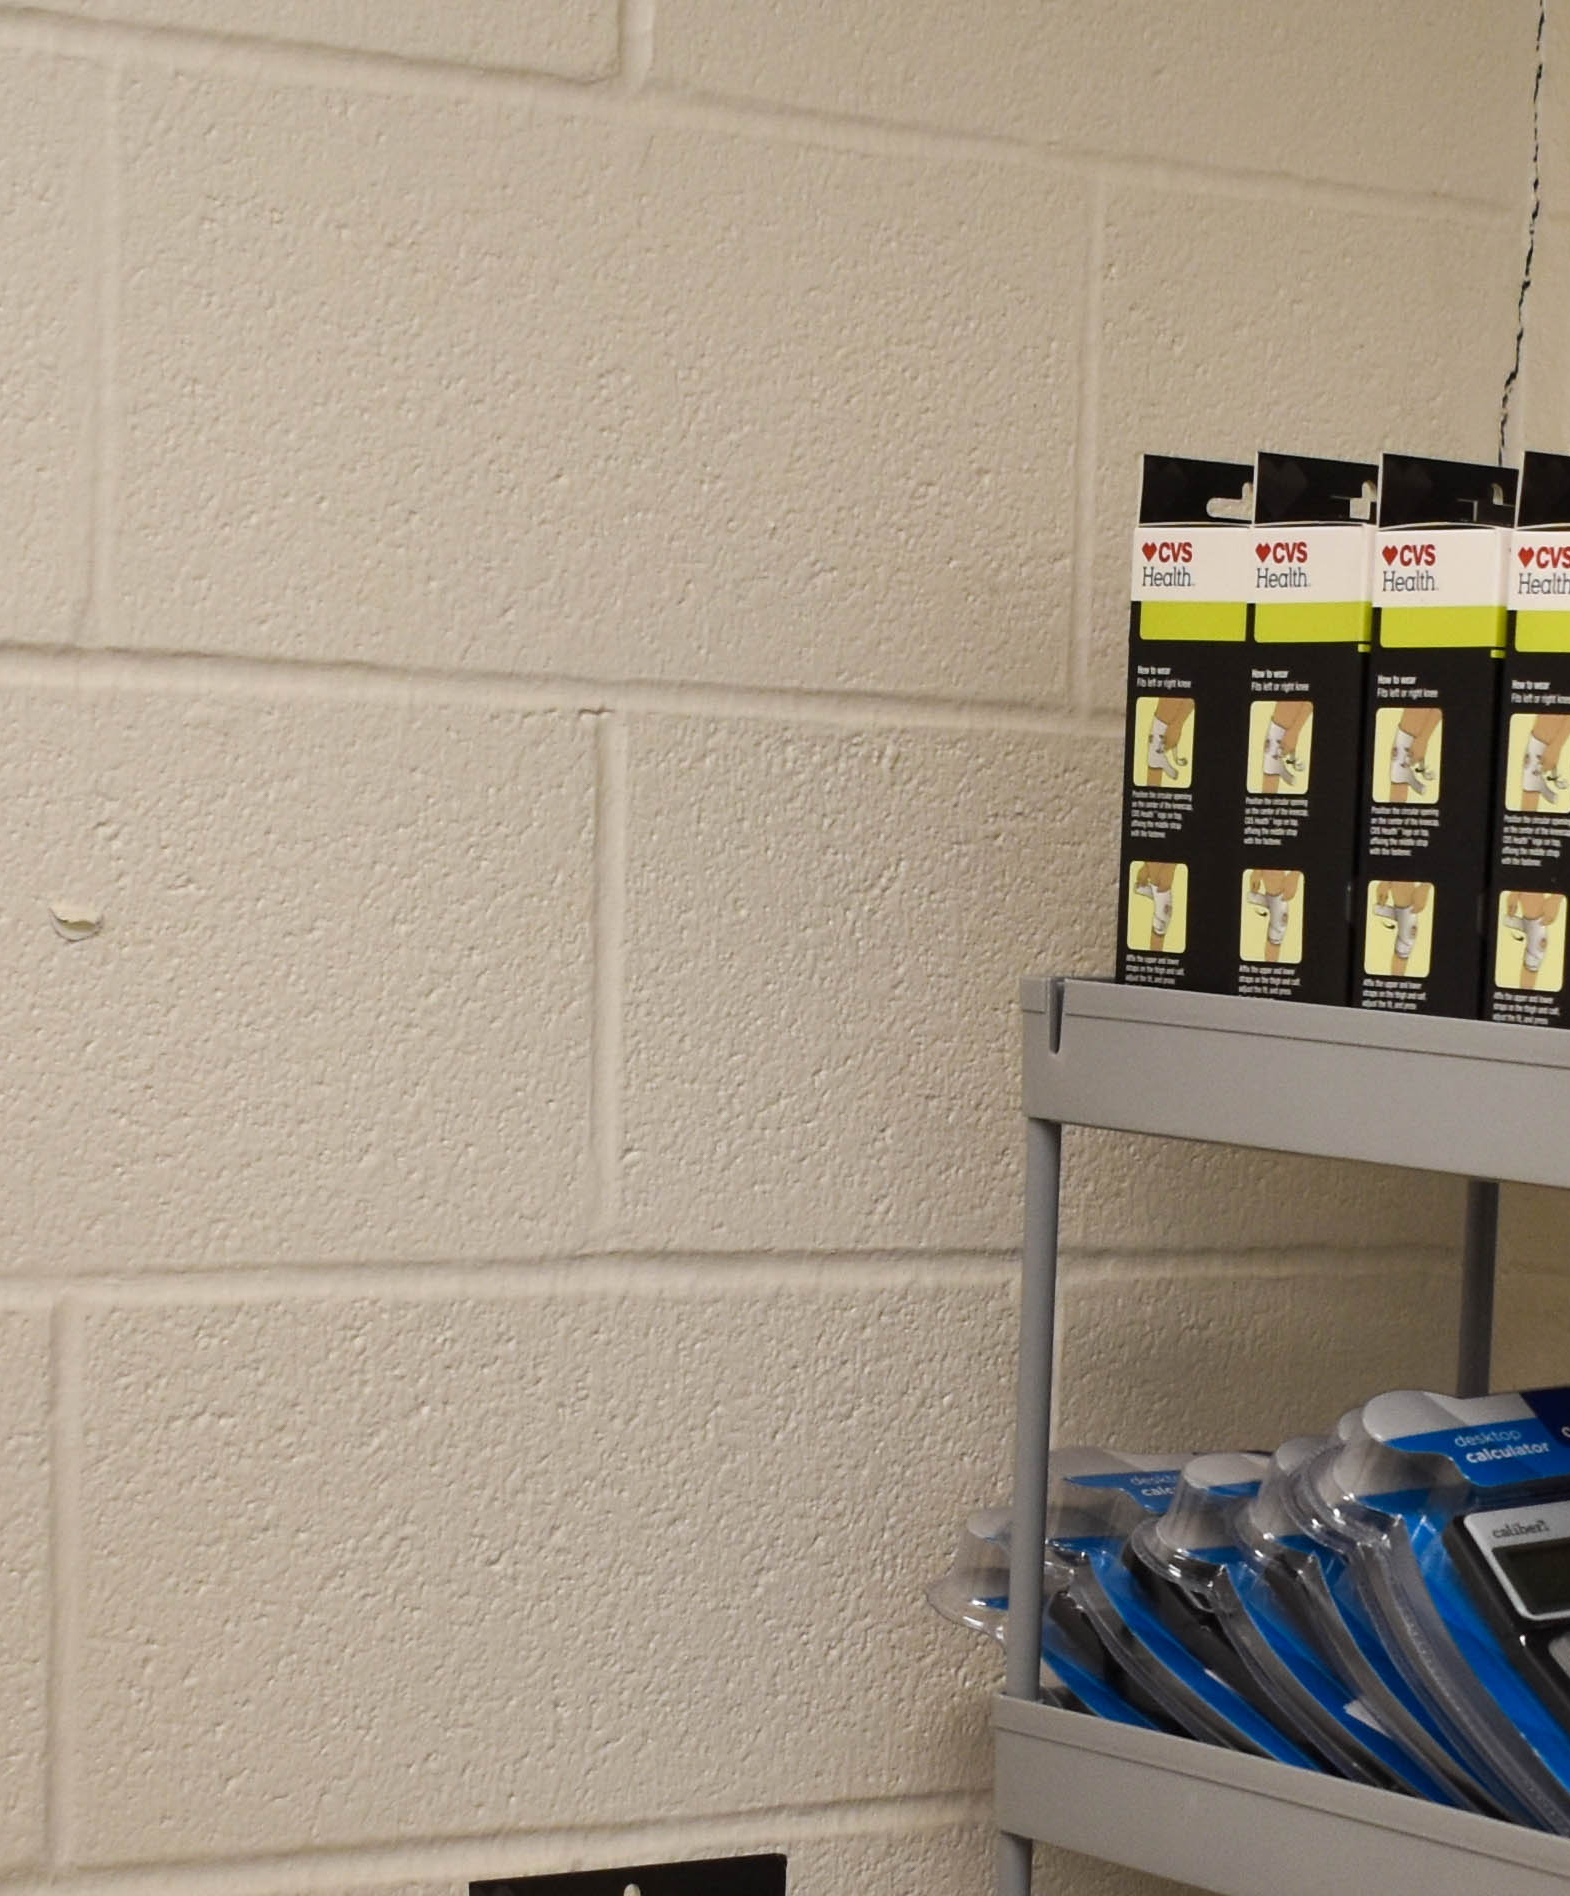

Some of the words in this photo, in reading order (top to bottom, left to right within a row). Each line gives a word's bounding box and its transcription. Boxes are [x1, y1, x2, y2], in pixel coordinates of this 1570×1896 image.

[1158, 541, 1193, 563] CVS
[1272, 541, 1308, 564] CVS
[1399, 544, 1436, 567] CVS
[1142, 566, 1192, 587] Health
[1255, 567, 1308, 588] Health
[1382, 570, 1436, 592] Health
[1454, 1427, 1522, 1448] desktop
[1465, 1441, 1550, 1464] calculator
